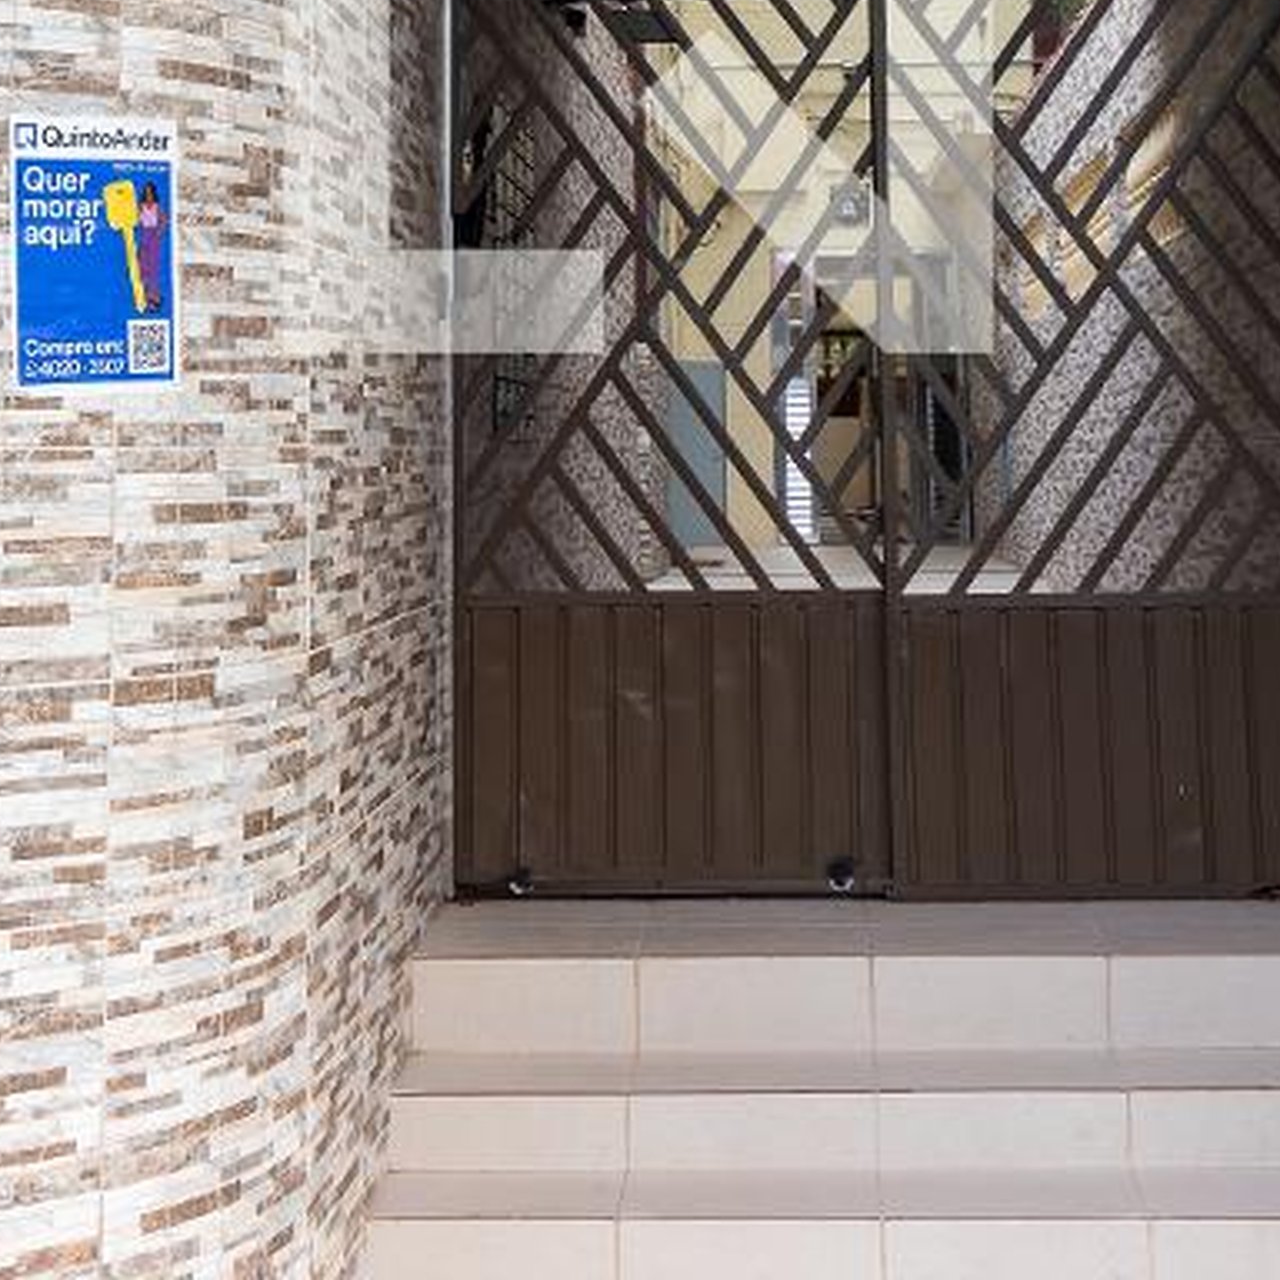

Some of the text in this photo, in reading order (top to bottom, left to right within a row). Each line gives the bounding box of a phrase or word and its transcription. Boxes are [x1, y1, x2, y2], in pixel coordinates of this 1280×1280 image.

[41, 124, 170, 151] QuintoAndar
[22, 166, 90, 193] Quer
[23, 199, 104, 219] morar
[24, 223, 96, 250] aqui?
